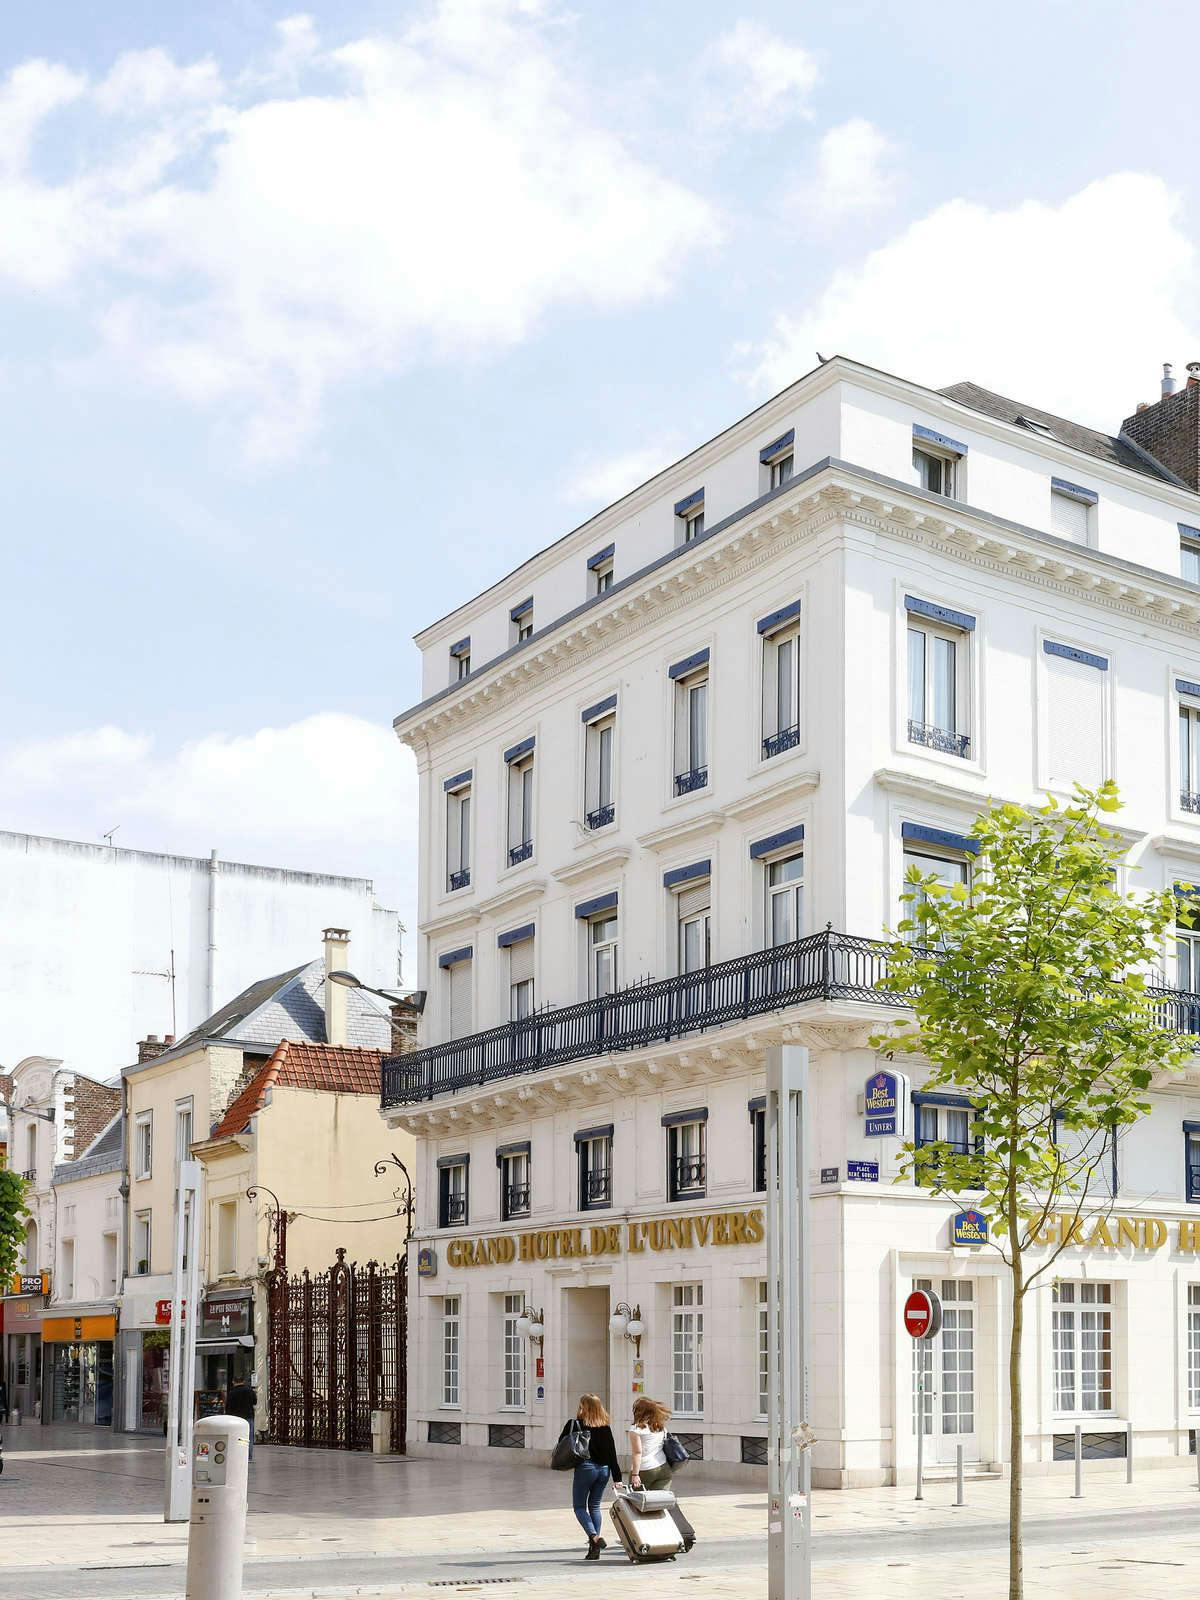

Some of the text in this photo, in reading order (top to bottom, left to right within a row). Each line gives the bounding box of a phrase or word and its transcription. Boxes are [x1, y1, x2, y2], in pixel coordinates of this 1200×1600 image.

[872, 1087, 889, 1099] Best
[866, 1098, 895, 1110] Western
[869, 1122, 893, 1132] UNIVERS
[962, 1221, 979, 1231] Best
[1027, 1211, 1168, 1249] GRAND
[446, 1209, 765, 1268] GRAND HOTEL DE L'UNIVERS
[956, 1229, 986, 1239] Western
[21, 1277, 42, 1285] PRO
